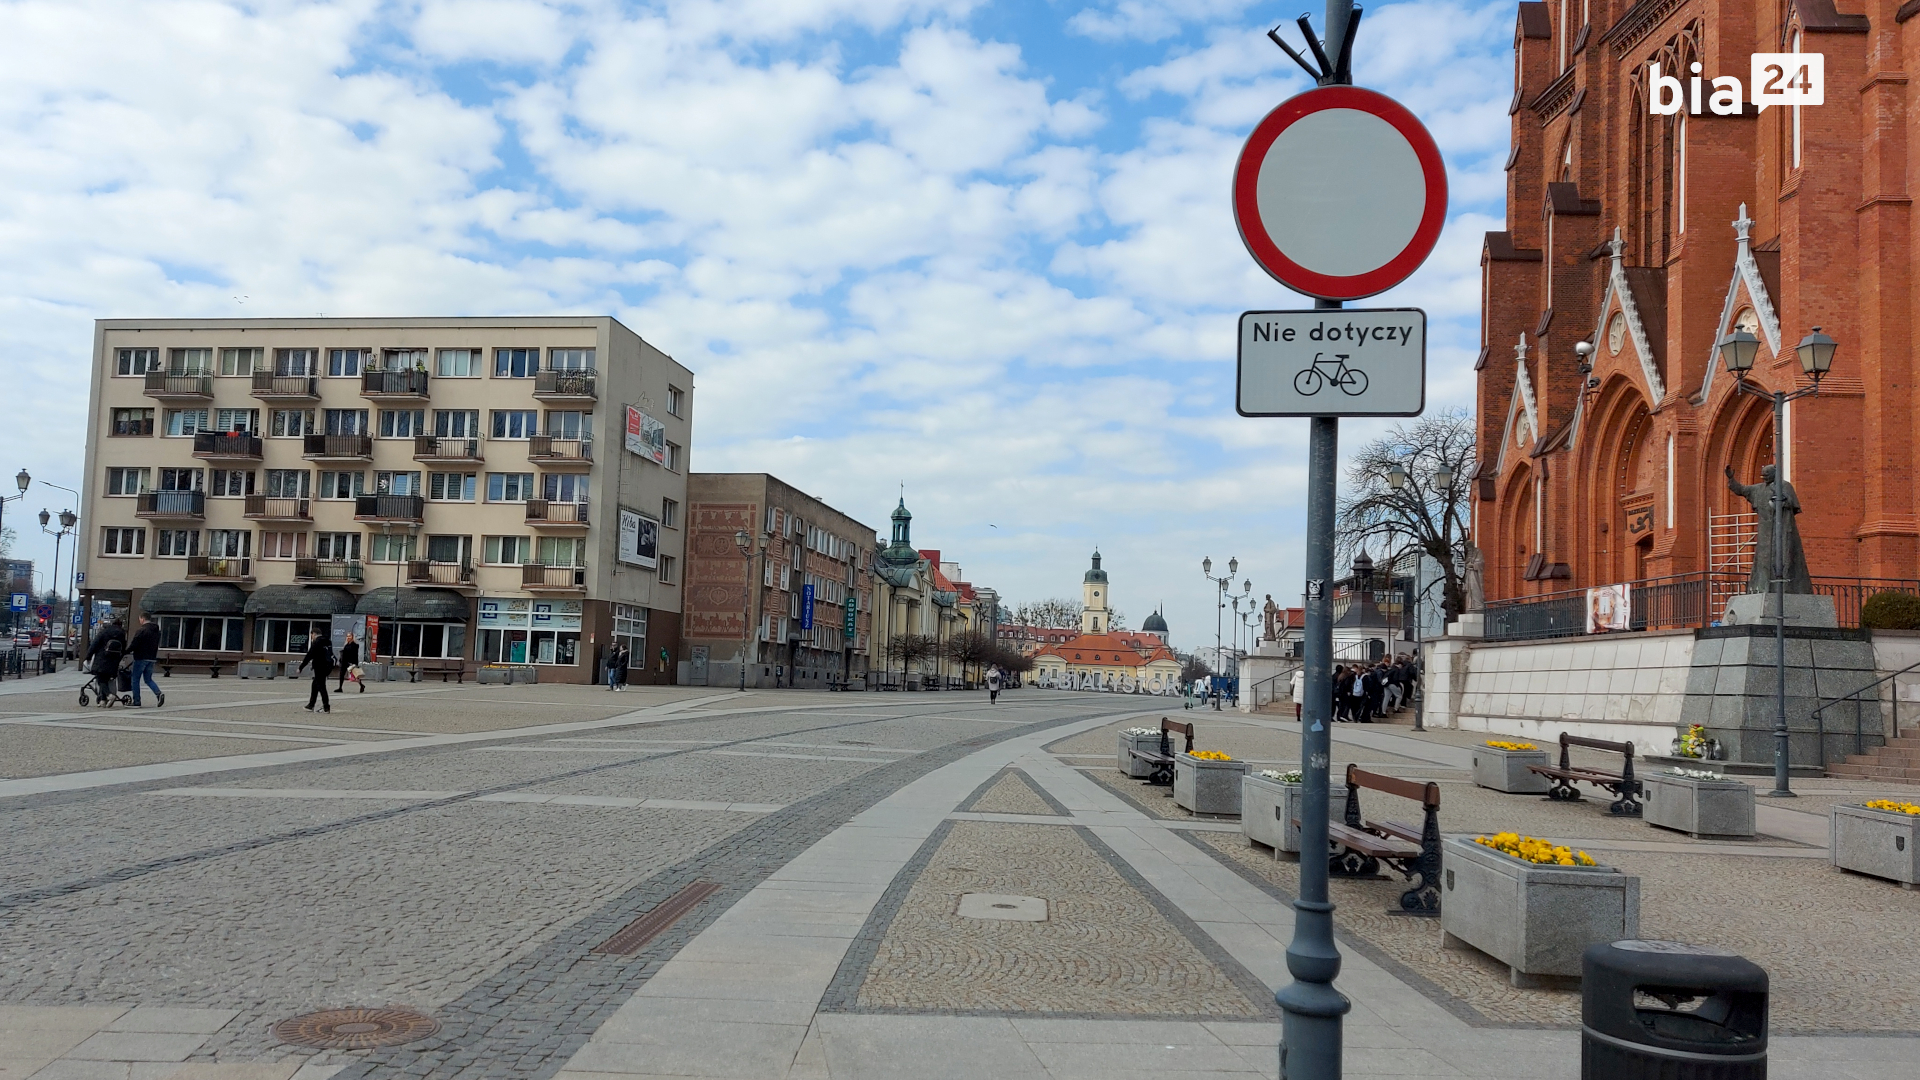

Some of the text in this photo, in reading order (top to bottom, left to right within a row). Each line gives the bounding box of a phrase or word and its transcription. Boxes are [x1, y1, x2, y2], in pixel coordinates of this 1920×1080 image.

[1253, 321, 1413, 347] Nie dotyczy
[78, 573, 83, 581] 2
[804, 586, 812, 628] NOTARIUSZ
[847, 598, 855, 632] ADWOKAT
